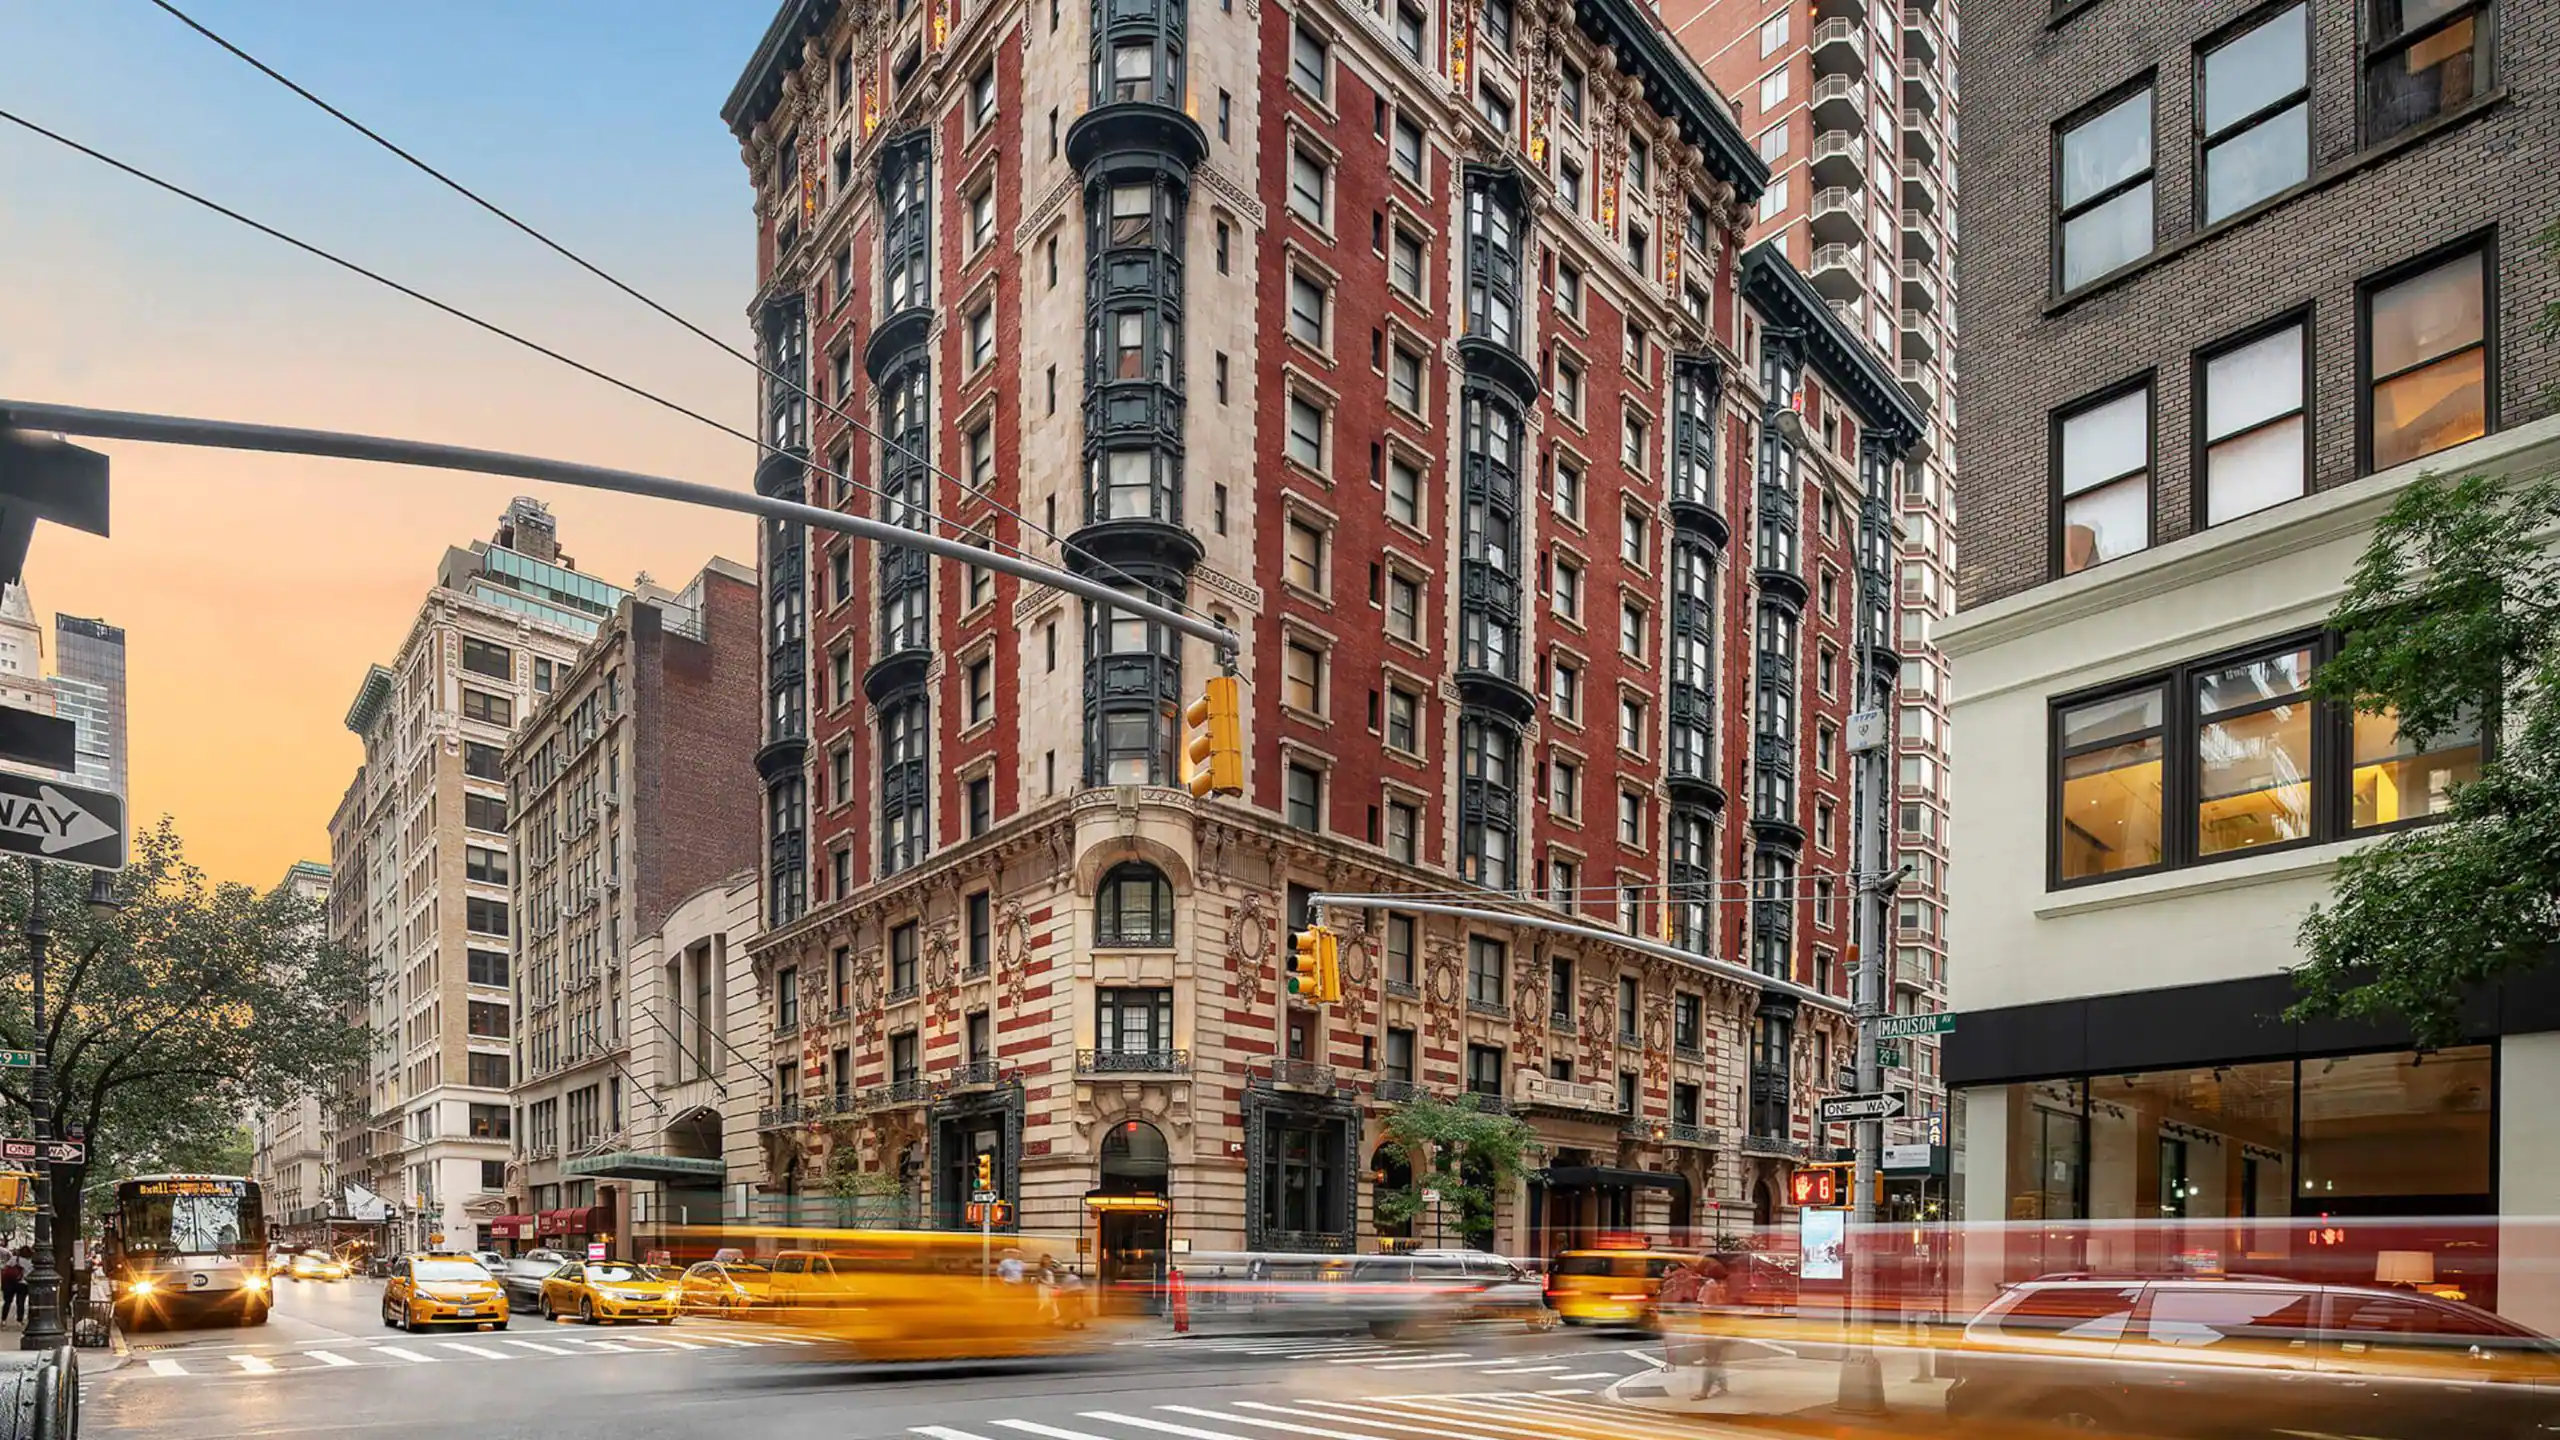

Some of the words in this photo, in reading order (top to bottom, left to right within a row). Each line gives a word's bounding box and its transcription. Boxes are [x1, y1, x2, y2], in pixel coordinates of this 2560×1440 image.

[1882, 1016, 1936, 1036] MADISON
[1941, 1015, 1952, 1023] AV
[0, 1052, 12, 1064] 9
[1880, 1050, 1890, 1064] 29
[1827, 1104, 1852, 1114] ONE
[1866, 1100, 1892, 1112] WAY
[9, 1145, 34, 1154] ONE
[1820, 1176, 1829, 1200] 6
